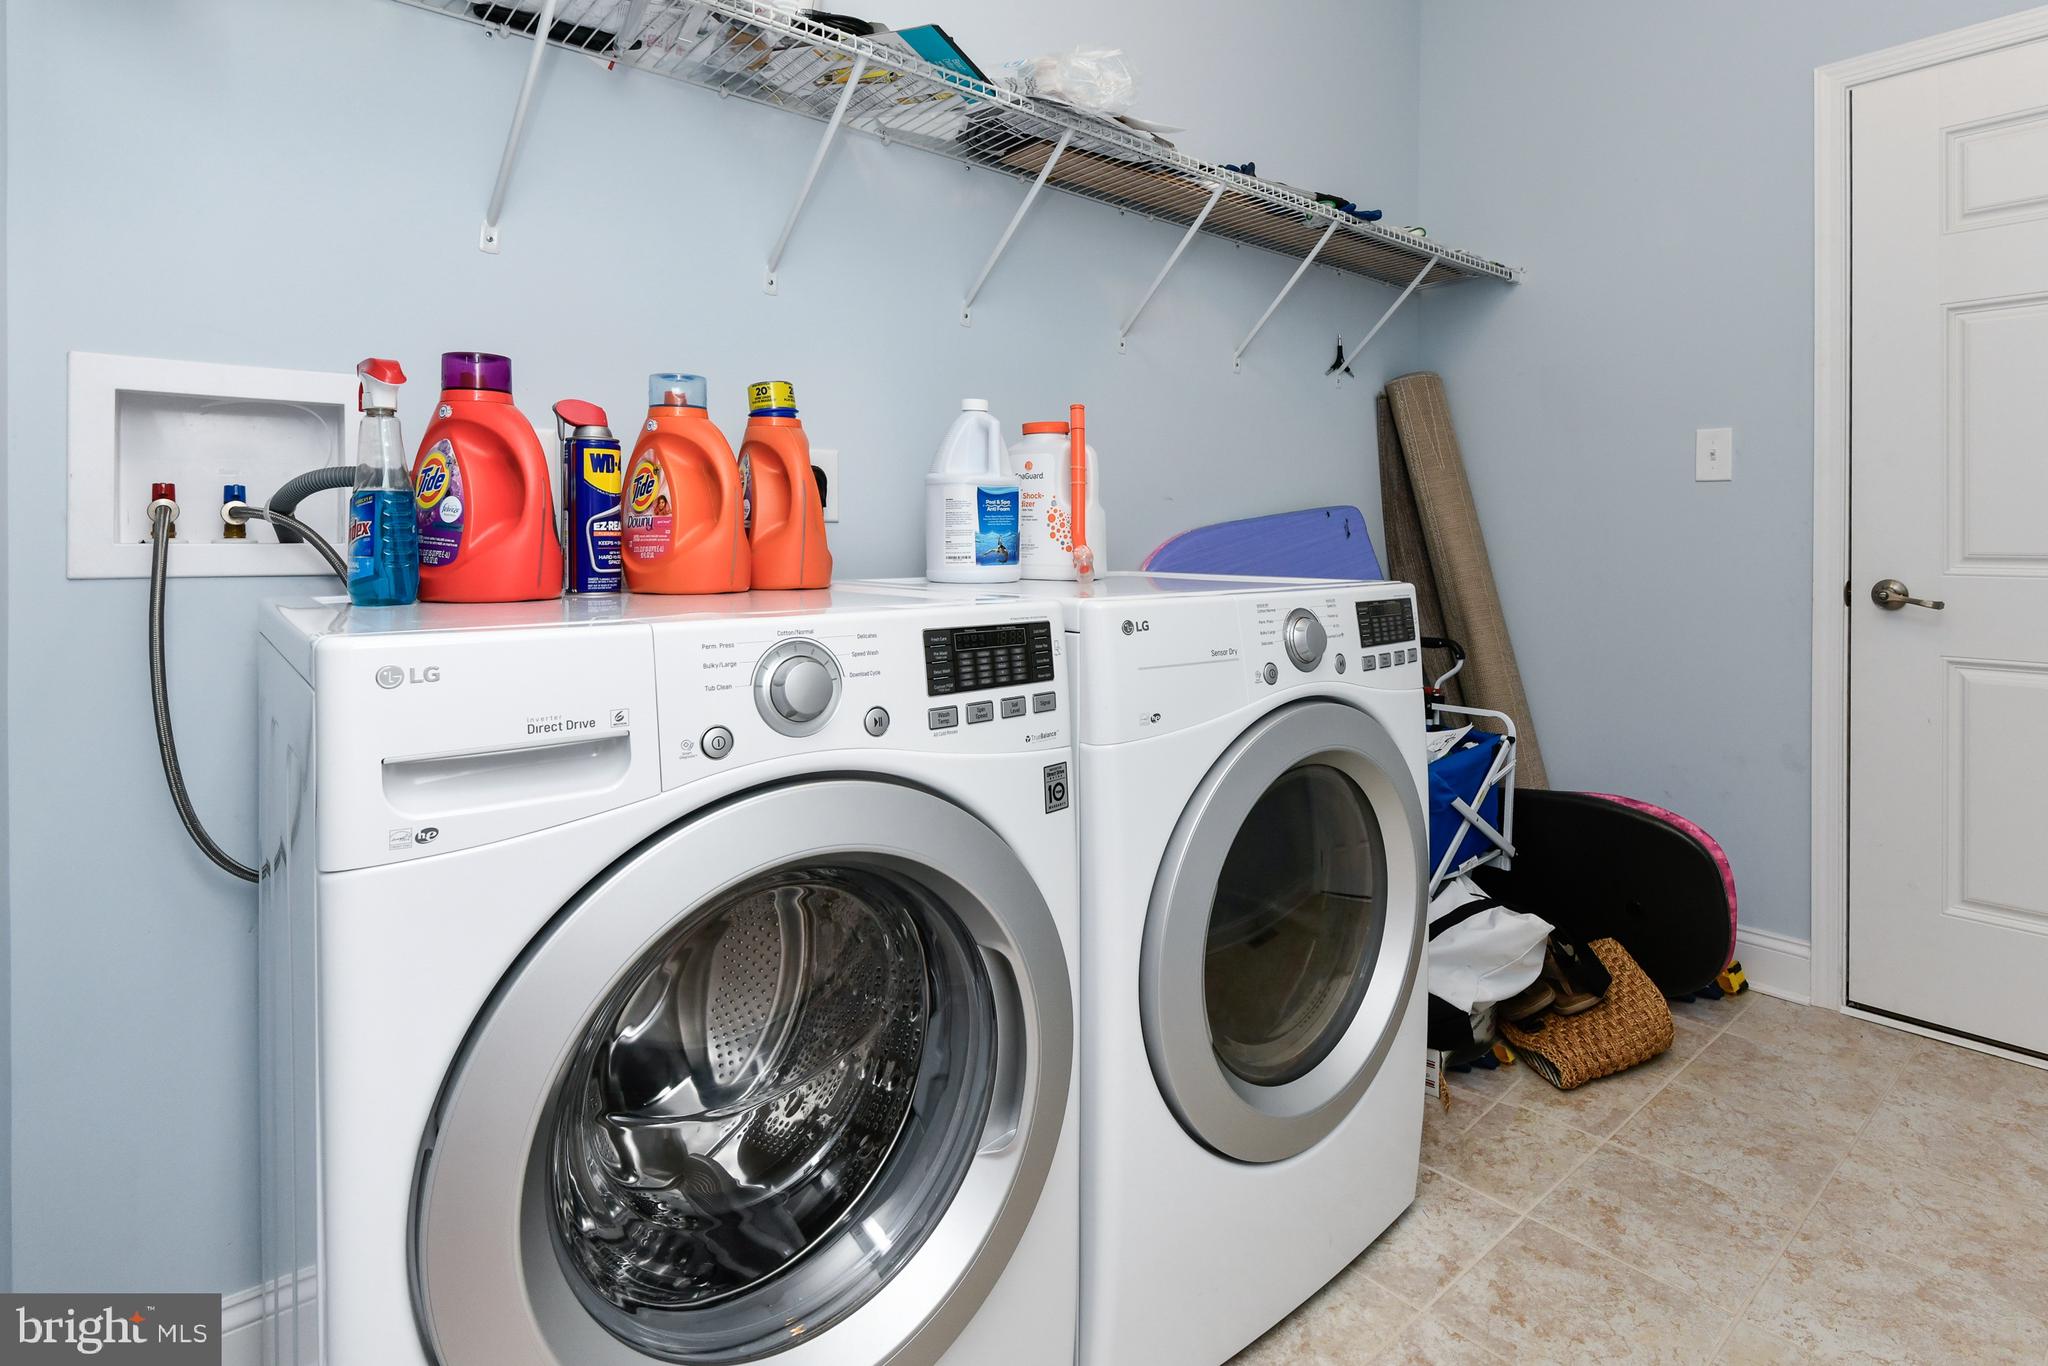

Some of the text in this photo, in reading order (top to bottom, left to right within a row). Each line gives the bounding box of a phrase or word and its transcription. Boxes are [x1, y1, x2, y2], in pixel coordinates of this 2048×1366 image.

[589, 453, 621, 473] WD-4
[417, 466, 446, 497] Tide
[1014, 472, 1044, 480] aGuard
[632, 474, 655, 503] Tide
[593, 521, 622, 531] EZ-REA
[627, 515, 654, 531] Downy
[776, 629, 814, 637] Cotton/Normal
[1136, 620, 1150, 632] LG
[1210, 647, 1238, 657] Sensor Dry
[702, 661, 738, 670] Bulky/Large
[409, 665, 440, 684] LG
[526, 715, 562, 723] inverter
[527, 719, 596, 735] Direct Drive
[1048, 782, 1065, 804] 10
